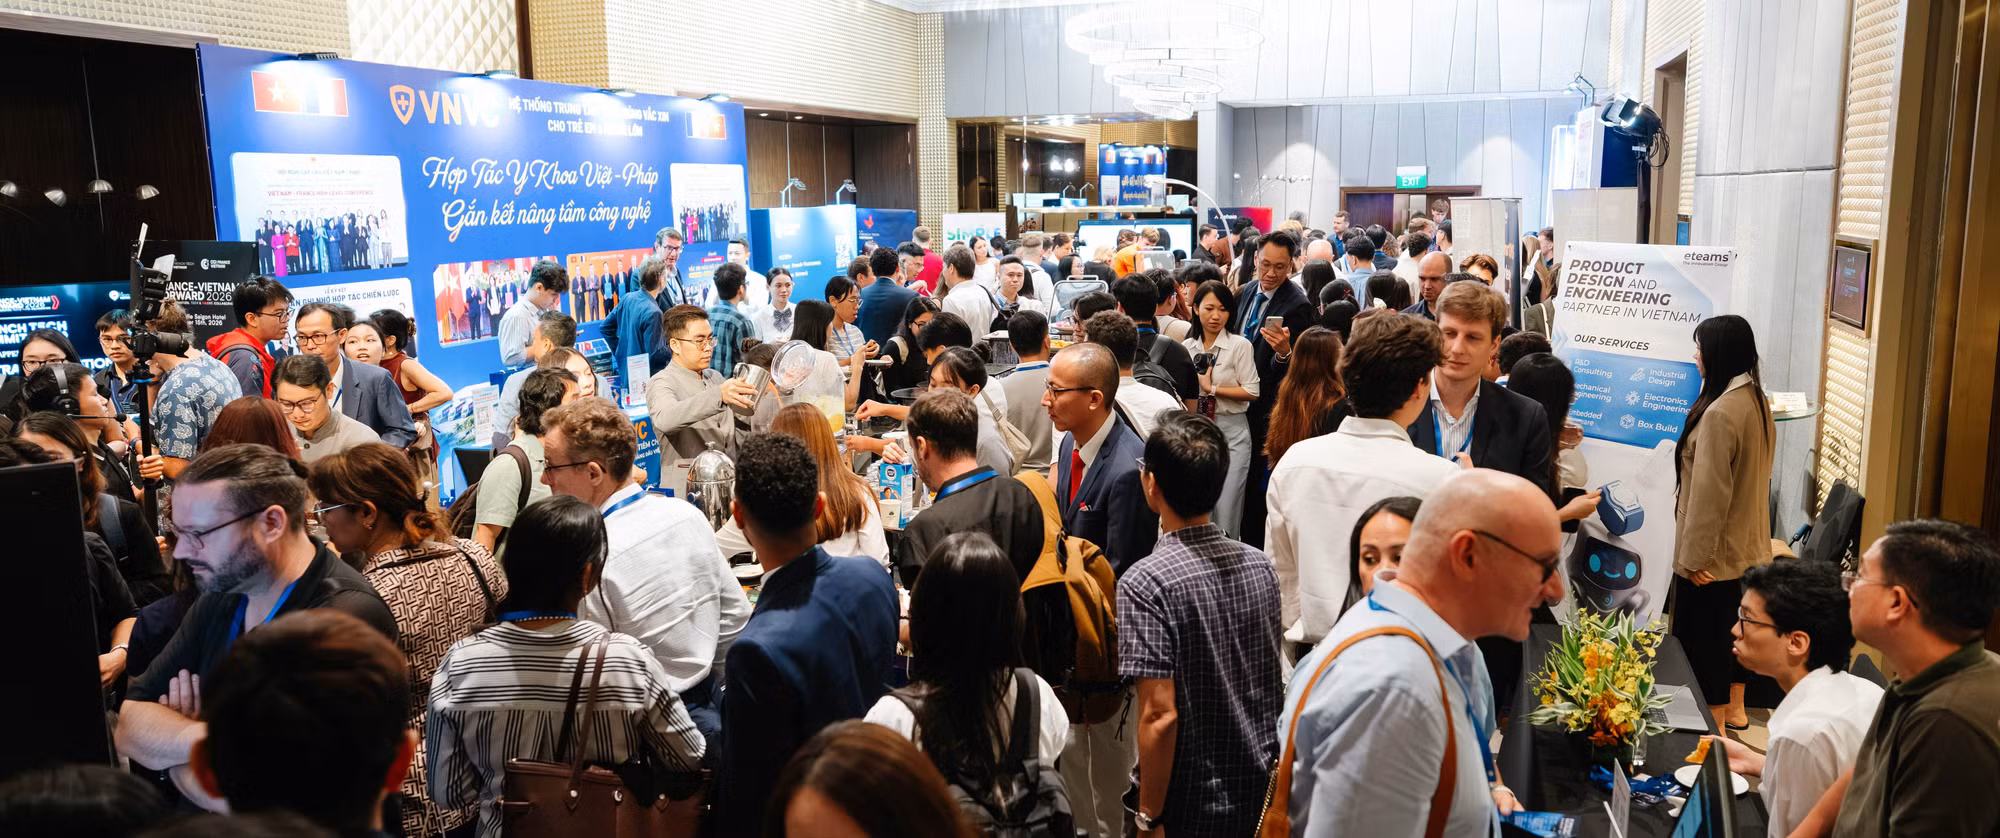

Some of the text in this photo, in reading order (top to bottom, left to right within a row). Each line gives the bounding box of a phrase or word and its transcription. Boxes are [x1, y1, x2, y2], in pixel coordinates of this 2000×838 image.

[418, 89, 500, 128] VNV
[522, 95, 552, 113] THỐNG
[553, 101, 581, 115] TRUNG
[657, 111, 669, 123] XIN
[547, 119, 566, 133] CHO
[566, 118, 583, 133] TRẺ
[422, 156, 468, 195] Hợp
[471, 157, 504, 189] Tác
[506, 159, 528, 196] Y
[530, 159, 578, 191] Khoa
[580, 160, 612, 190] Việt
[621, 161, 659, 193] Pháp
[1402, 177, 1419, 186] EXIT
[442, 197, 652, 243] Gắn kết nâng tầm công nghệ
[1684, 252, 1729, 262] eteams
[1569, 259, 1645, 275] PRODUCT
[166, 281, 240, 292] ANCE-VIETNAM
[1566, 272, 1657, 291] DESIGN AND
[164, 290, 233, 301] ORWARD 2026
[1564, 286, 1672, 306] ENGINEERING
[194, 313, 211, 321] Saigon
[1562, 301, 1702, 324] PARTNER IN VIETNAM
[1574, 333, 1650, 351] OUR SERVICES
[1575, 358, 1590, 366] R&D
[1573, 365, 1613, 378] Consulting
[1650, 368, 1687, 380] Industrial
[1575, 383, 1611, 394] echanical
[1648, 377, 1676, 387] Design
[1644, 392, 1688, 406] Electronics
[1642, 400, 1692, 415] Engineering
[1568, 409, 1602, 420] Embedded
[1637, 420, 1678, 433] Box Build
